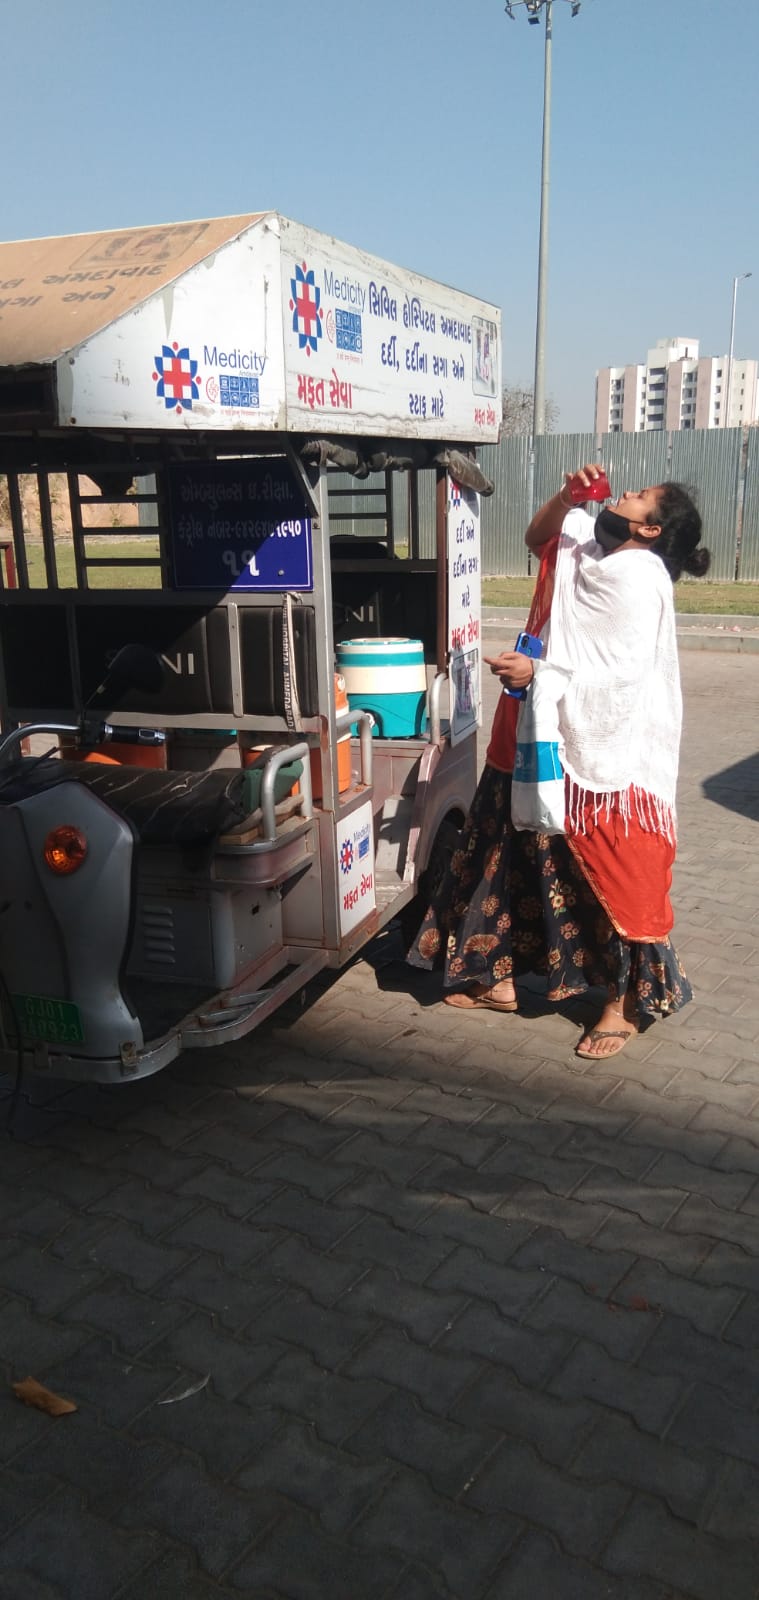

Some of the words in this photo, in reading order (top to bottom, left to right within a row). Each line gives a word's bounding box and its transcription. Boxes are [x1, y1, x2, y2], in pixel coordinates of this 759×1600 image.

[42, 263, 168, 285] અમદાવાદ
[324, 268, 366, 313] Medicity
[368, 281, 397, 321] સિવિલ
[440, 315, 472, 344] અમદાવાદ
[203, 345, 266, 376] Medicity
[405, 341, 428, 376] દર્દીના
[297, 374, 325, 410] મફત
[329, 367, 353, 409] સેવા
[431, 389, 445, 418] માટે
